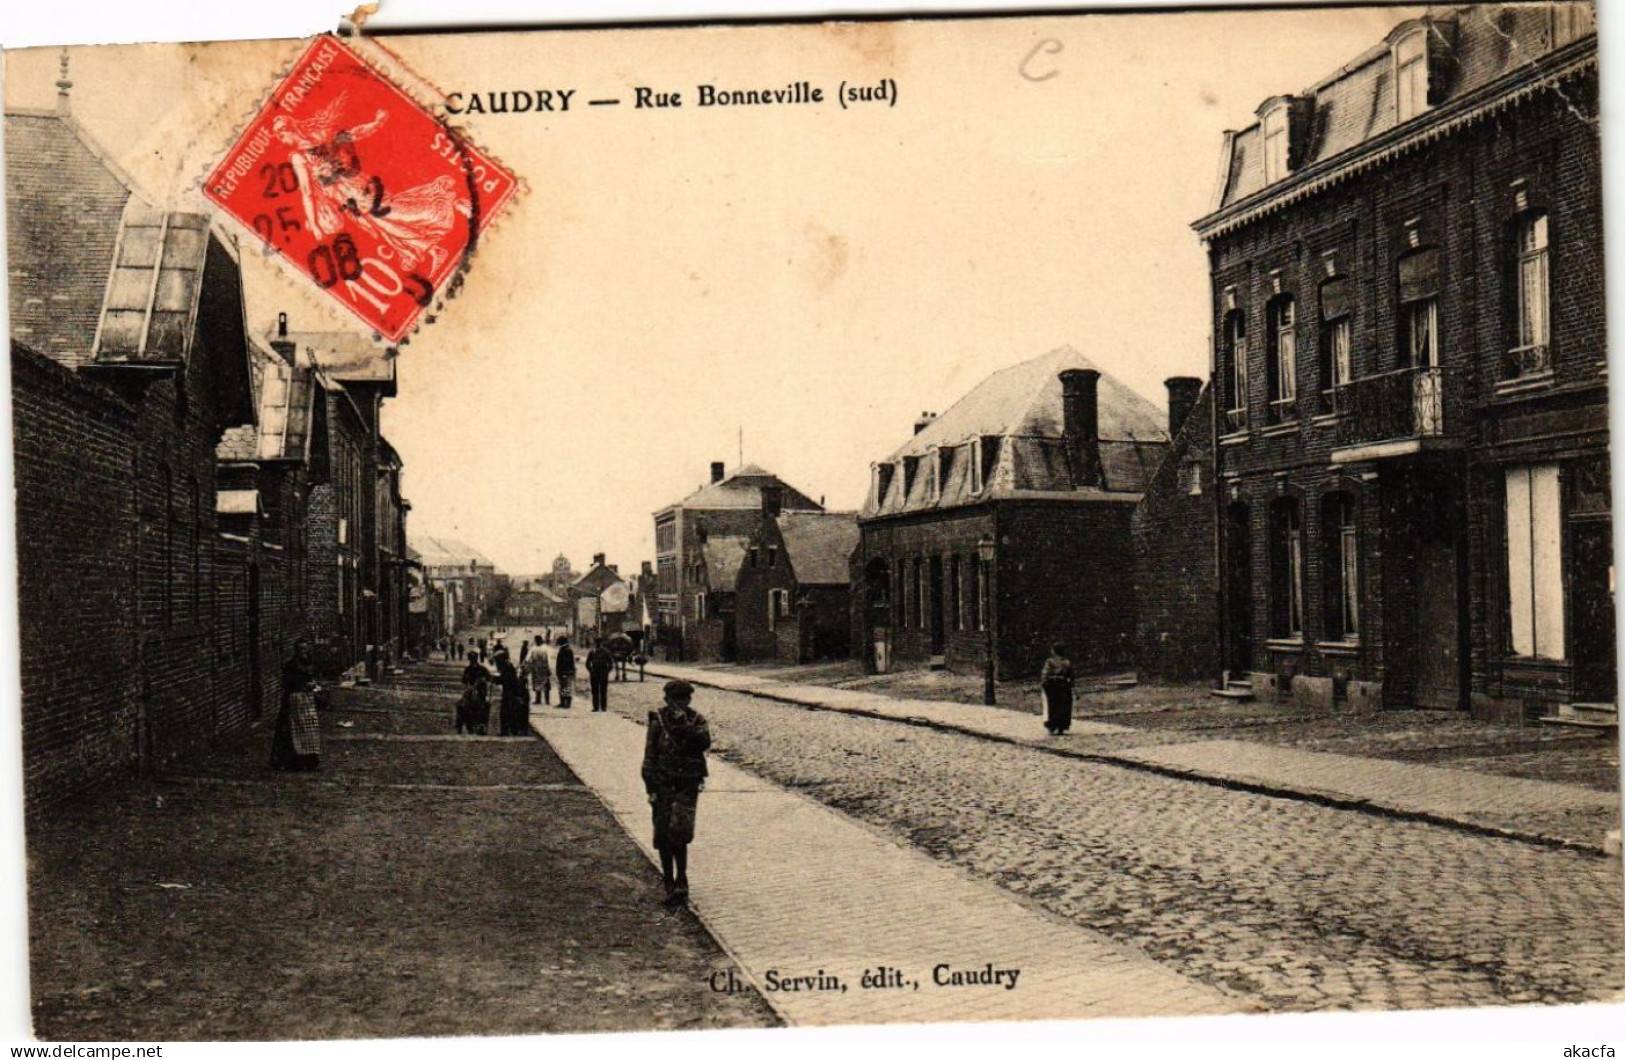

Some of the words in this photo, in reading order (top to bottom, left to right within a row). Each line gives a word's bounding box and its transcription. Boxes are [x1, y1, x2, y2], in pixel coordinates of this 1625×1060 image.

[443, 88, 577, 114] CAUDRY
[634, 86, 683, 109] Rue
[697, 80, 825, 107] Bonneville
[838, 78, 899, 109] (sud)
[307, 232, 362, 289] 08
[709, 970, 751, 993] Ch.
[765, 968, 849, 994] Servin,
[860, 966, 920, 991] édit.,
[932, 963, 1021, 990] Caudry
